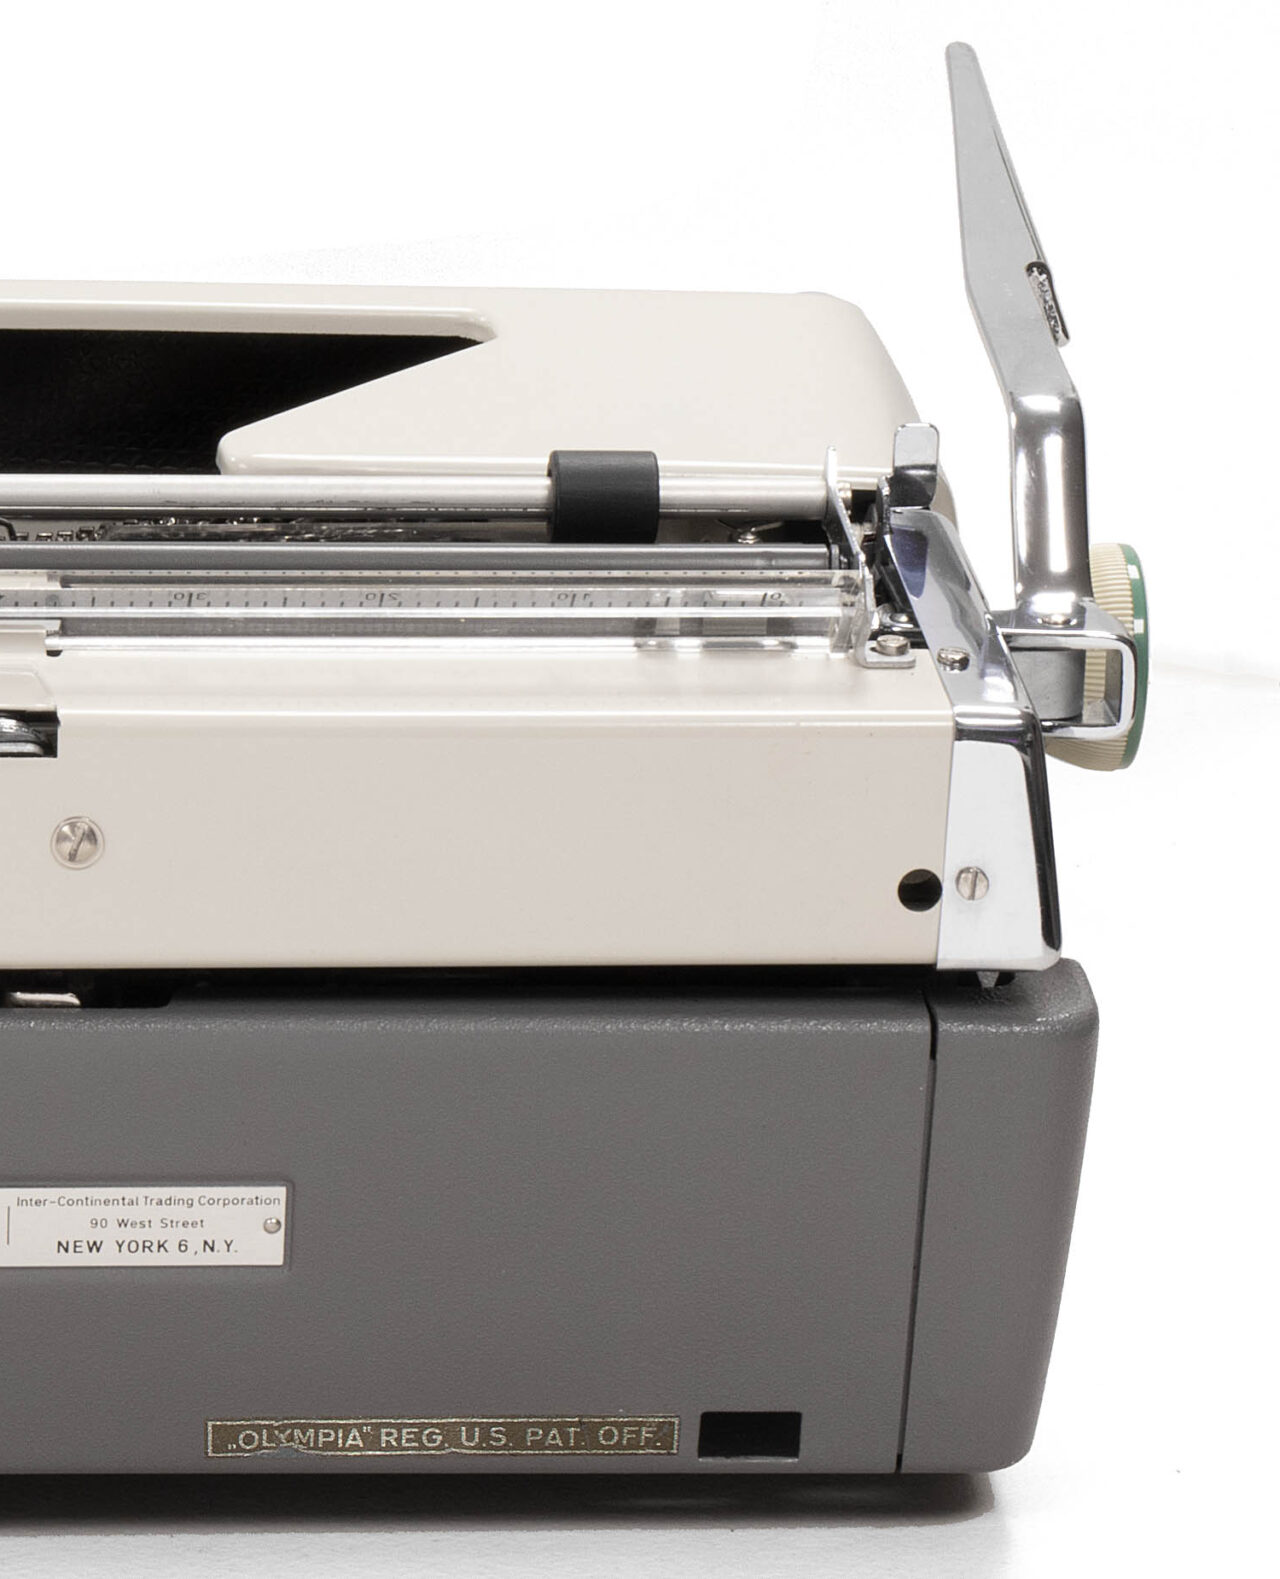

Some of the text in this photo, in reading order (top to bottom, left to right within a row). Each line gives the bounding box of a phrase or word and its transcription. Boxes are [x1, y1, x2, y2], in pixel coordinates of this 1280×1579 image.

[16, 1195, 281, 1208] Inter-Continental Trading Corporation
[90, 1218, 205, 1229] 90 West Street
[57, 1240, 104, 1254] NEW
[115, 1240, 169, 1253] YORK
[381, 1428, 448, 1448] REG.
[461, 1426, 512, 1447] U.S.
[526, 1427, 585, 1447] PAT.
[598, 1426, 662, 1447] OFF.
